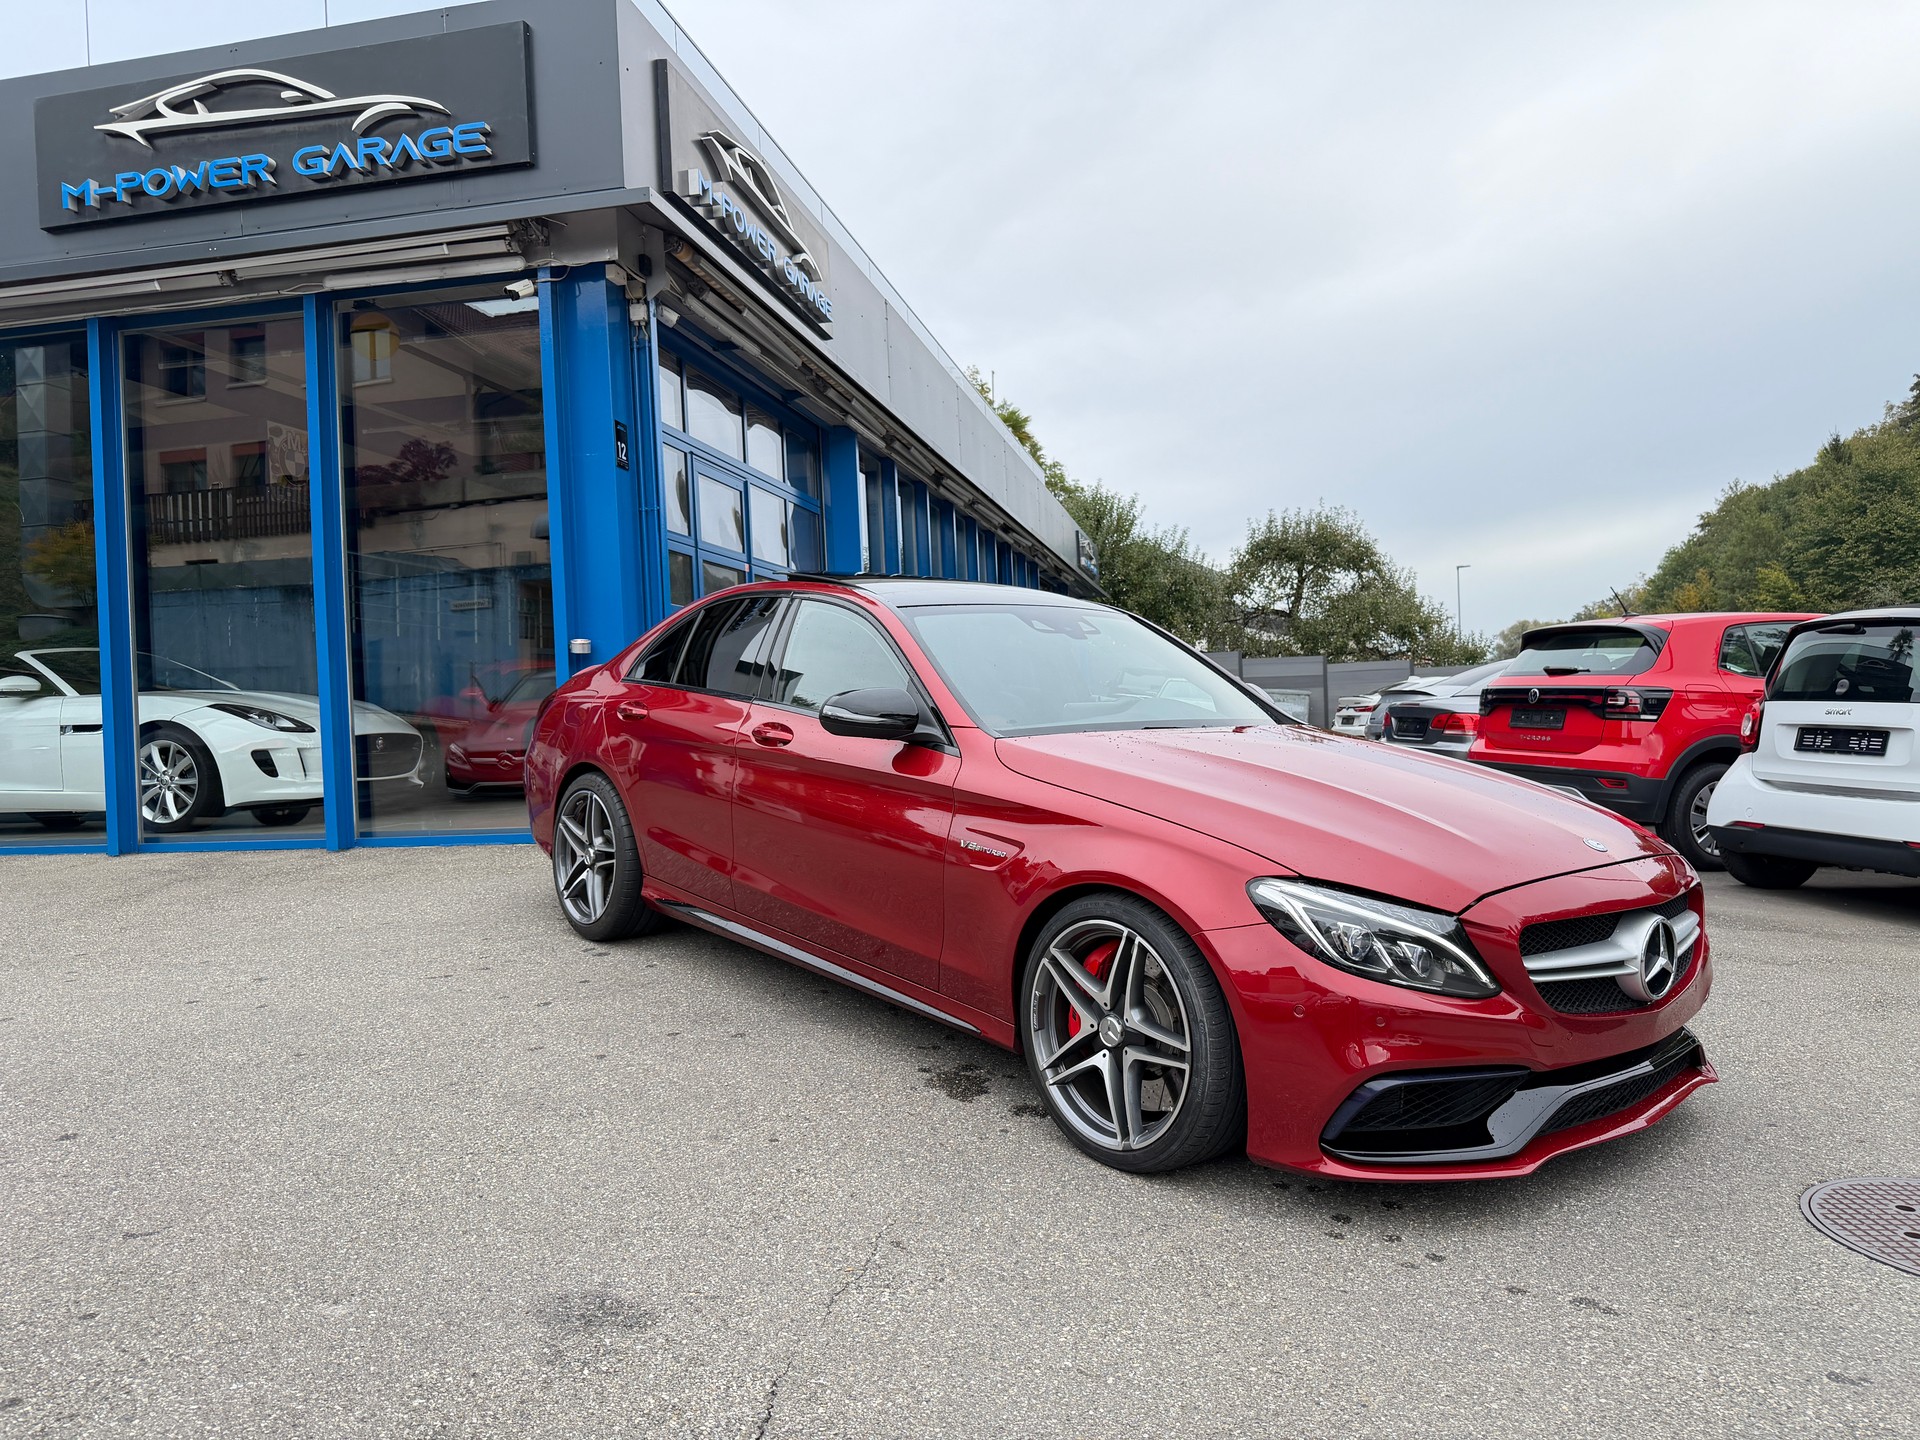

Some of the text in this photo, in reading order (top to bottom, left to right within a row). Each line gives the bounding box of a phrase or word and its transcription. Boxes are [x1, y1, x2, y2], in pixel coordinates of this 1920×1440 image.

[61, 121, 489, 210] M-POWER GARAGE
[697, 169, 833, 322] M-POWER GARAGE
[617, 441, 627, 460] 12
[1824, 708, 1853, 716] smart
